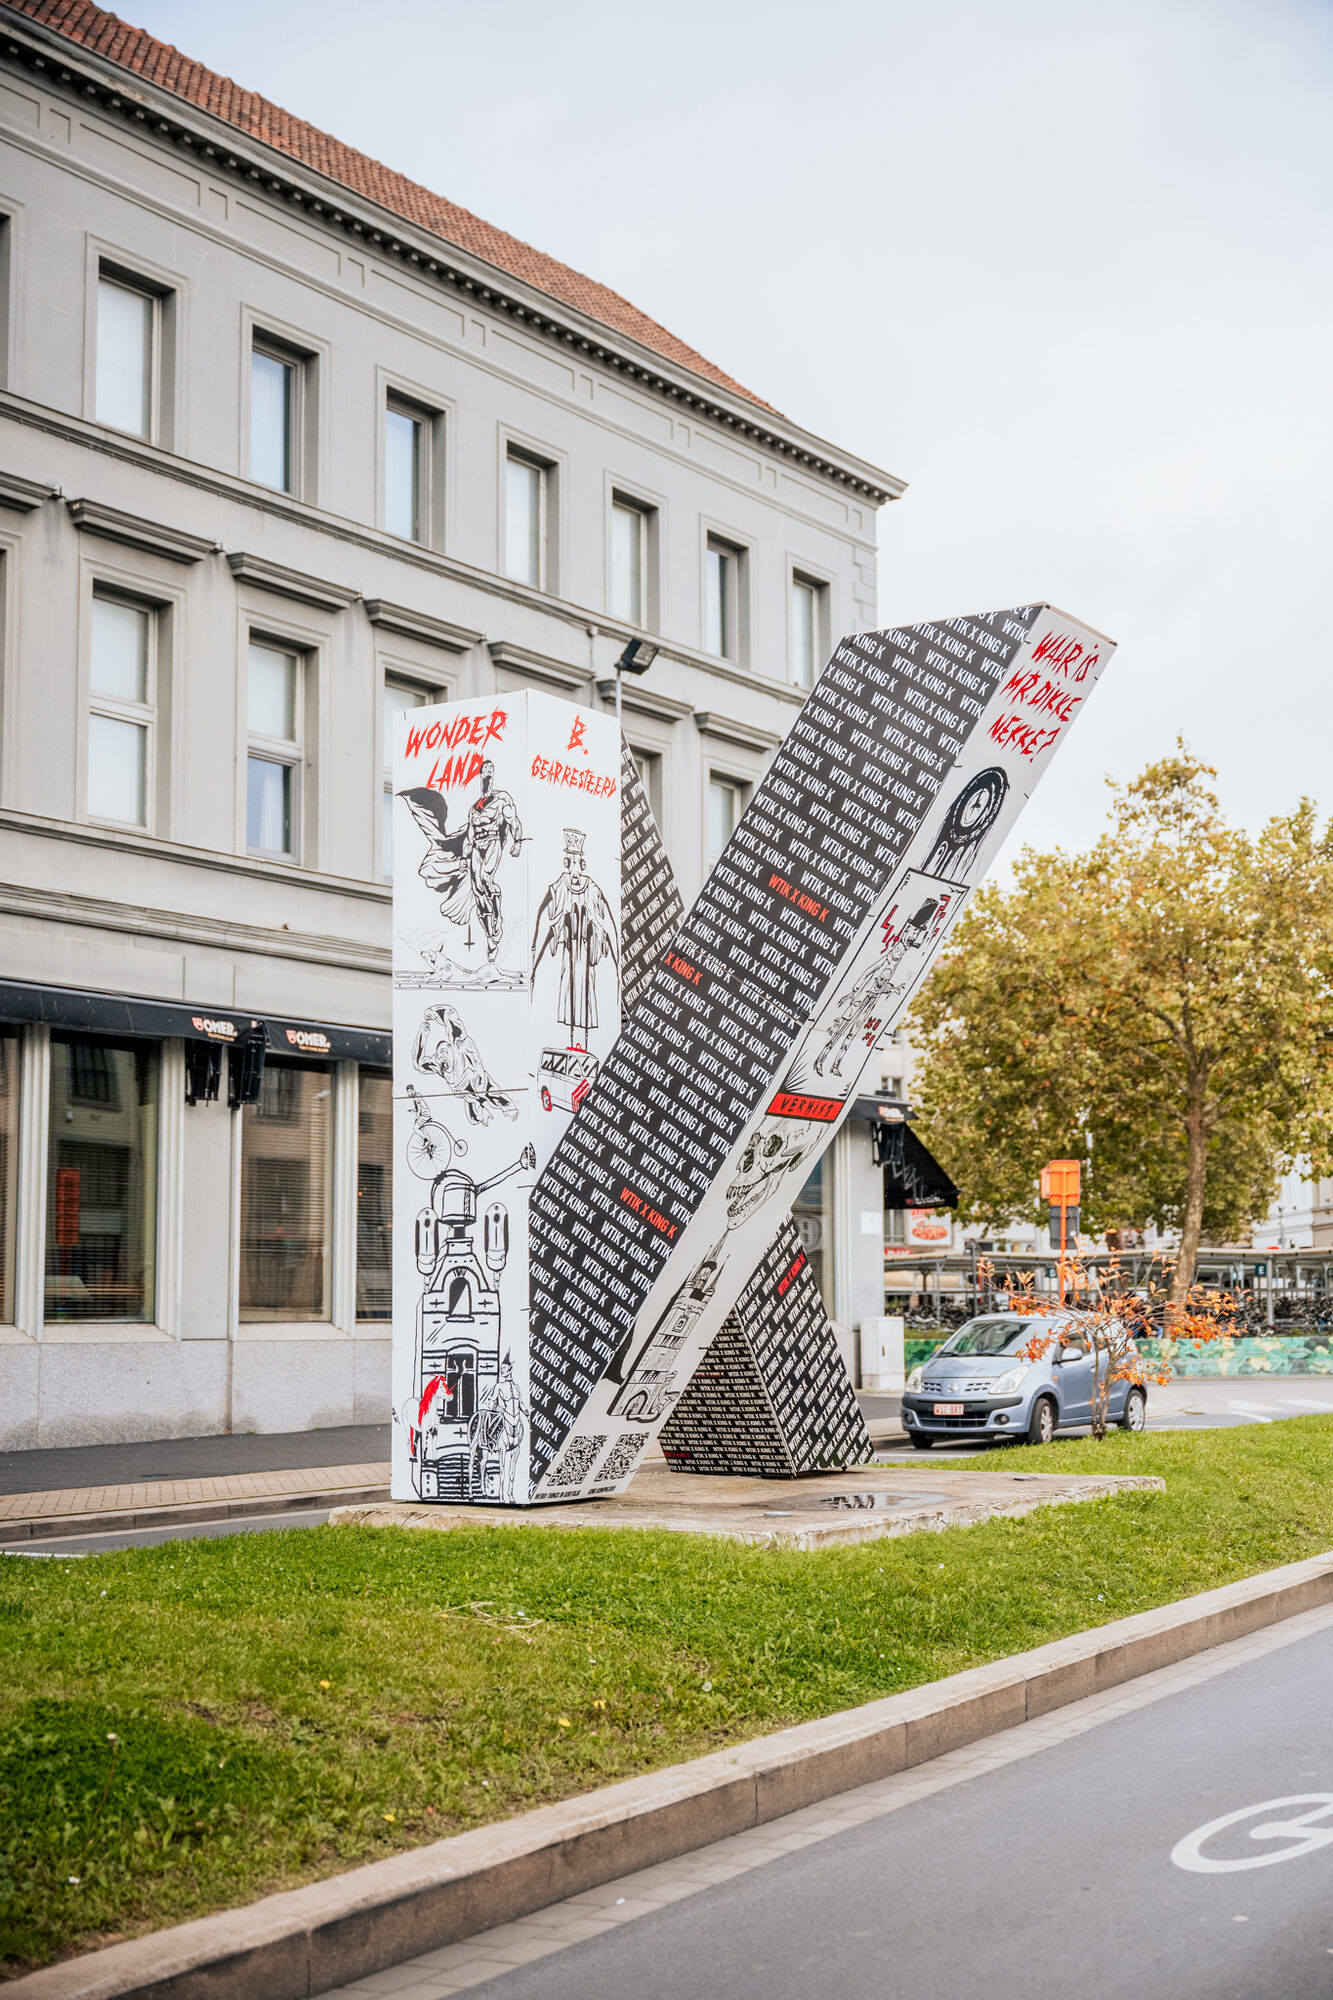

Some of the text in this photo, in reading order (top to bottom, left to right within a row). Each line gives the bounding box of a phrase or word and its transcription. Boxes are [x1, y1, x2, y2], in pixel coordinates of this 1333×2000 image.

[836, 646, 968, 735] WTIK X KING K WTIK X KING K
[934, 631, 946, 645] X
[942, 635, 967, 658] KING
[965, 649, 976, 664] K
[981, 656, 1008, 680] WTIK
[1031, 630, 1083, 678] WAAR
[405, 706, 509, 758] WONDER
[425, 750, 486, 792] LAND
[566, 715, 589, 755] B.
[804, 701, 942, 794] X KING K WTIK X KING K WTIK
[475, 796, 489, 810] K
[775, 756, 904, 846] WTIK X KING K WTIK X KING K
[724, 845, 857, 942] X KING K WTIK X KING K WTIK
[664, 952, 793, 1052] X KING K WTIK X KING K WTIK
[616, 1038, 737, 1135] WTIK X KING K WTIK X KING K
[587, 1090, 712, 1192] X KING K WTIK X KING K WTIK
[559, 1140, 678, 1239] WTIK X KING K WTIK X KING K
[540, 1222, 639, 1307] X KING K WTIK X KING K
[533, 1289, 614, 1362] WTIK X KING K WTIK
[534, 1437, 556, 1462] WTIK
